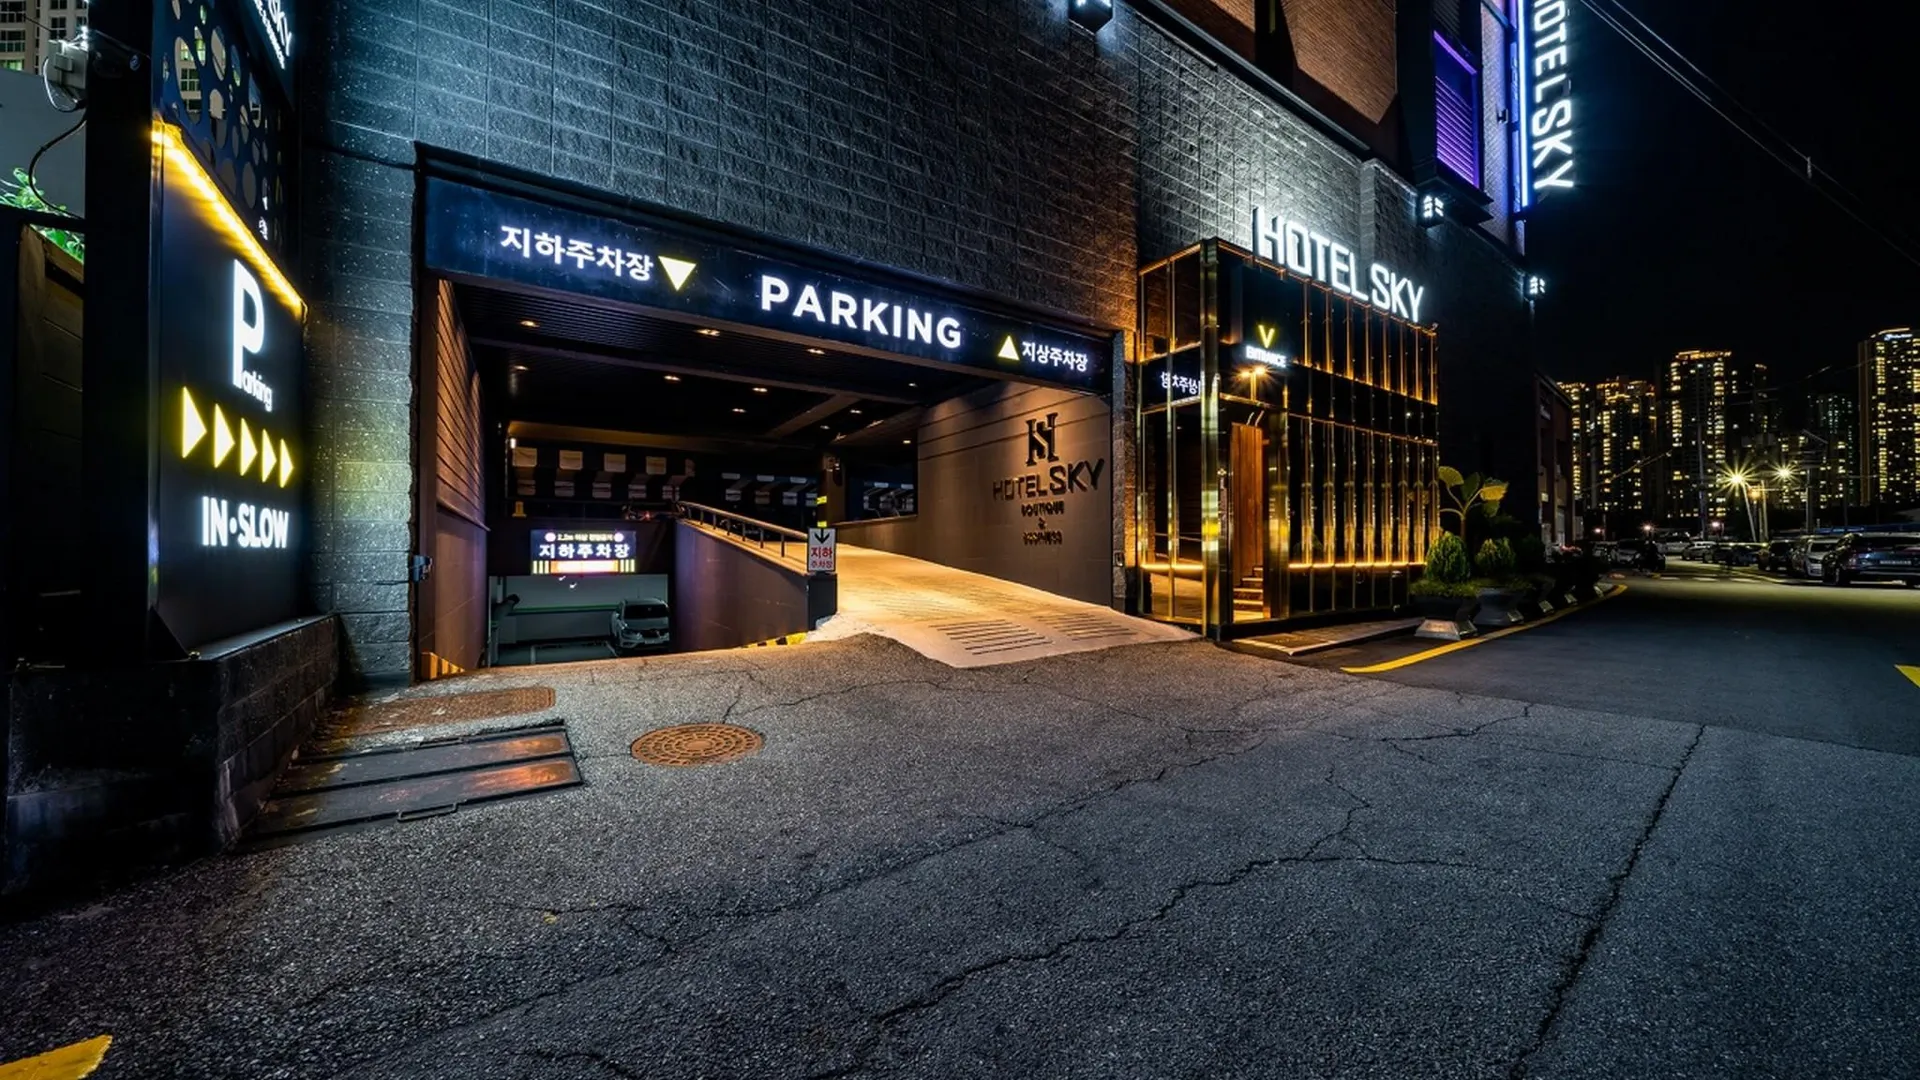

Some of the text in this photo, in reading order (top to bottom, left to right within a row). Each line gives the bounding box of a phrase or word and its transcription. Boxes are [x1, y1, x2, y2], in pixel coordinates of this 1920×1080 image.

[1534, 0, 1568, 104] OTEL
[501, 225, 654, 281] 지하주차장
[1254, 206, 1424, 323] HOTEL SKY
[761, 275, 962, 348] PARKING
[1021, 341, 1088, 372] 지상주차장
[992, 458, 1105, 501] HOTEL SKY
[539, 543, 630, 559] 지하주차장
[811, 547, 833, 558] 지하
